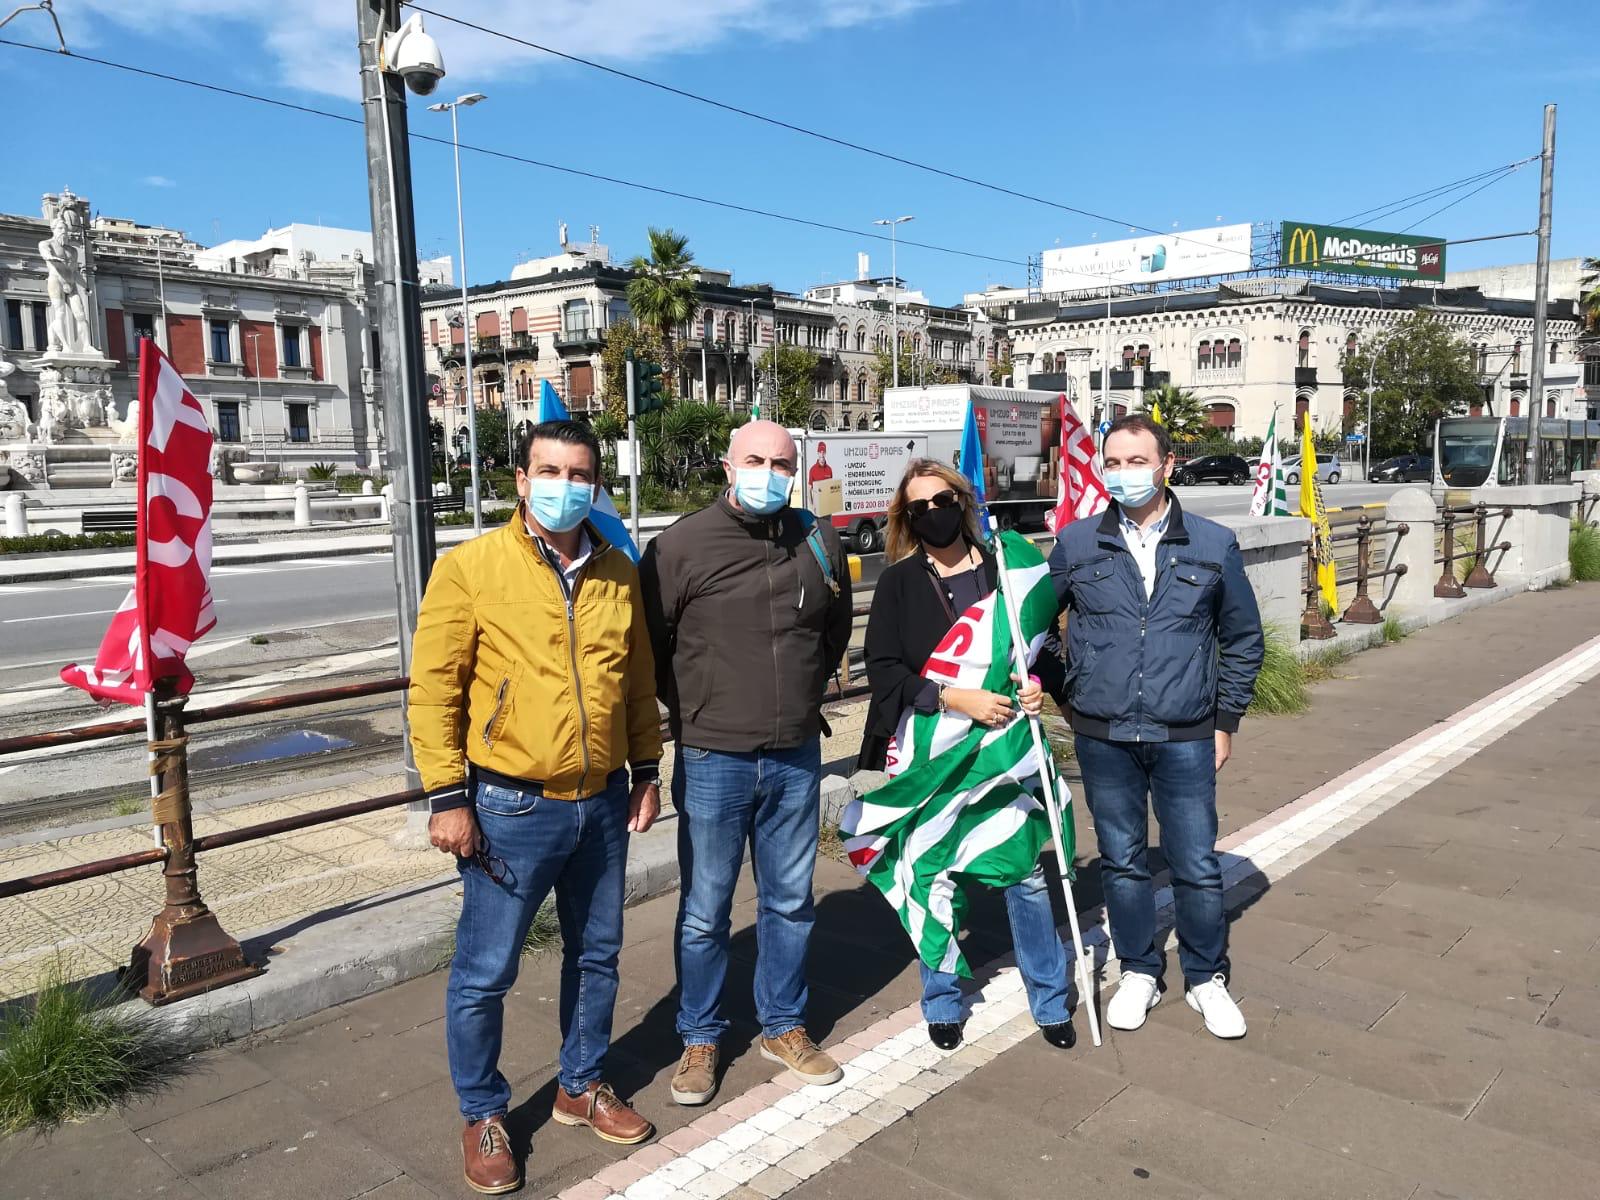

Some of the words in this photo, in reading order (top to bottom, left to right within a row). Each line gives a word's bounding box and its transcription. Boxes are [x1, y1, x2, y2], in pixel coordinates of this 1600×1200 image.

[1322, 236, 1417, 265] McDonald's
[843, 447, 868, 457] UMZUG
[880, 446, 904, 456] PROFIS
[865, 500, 877, 509] 200
